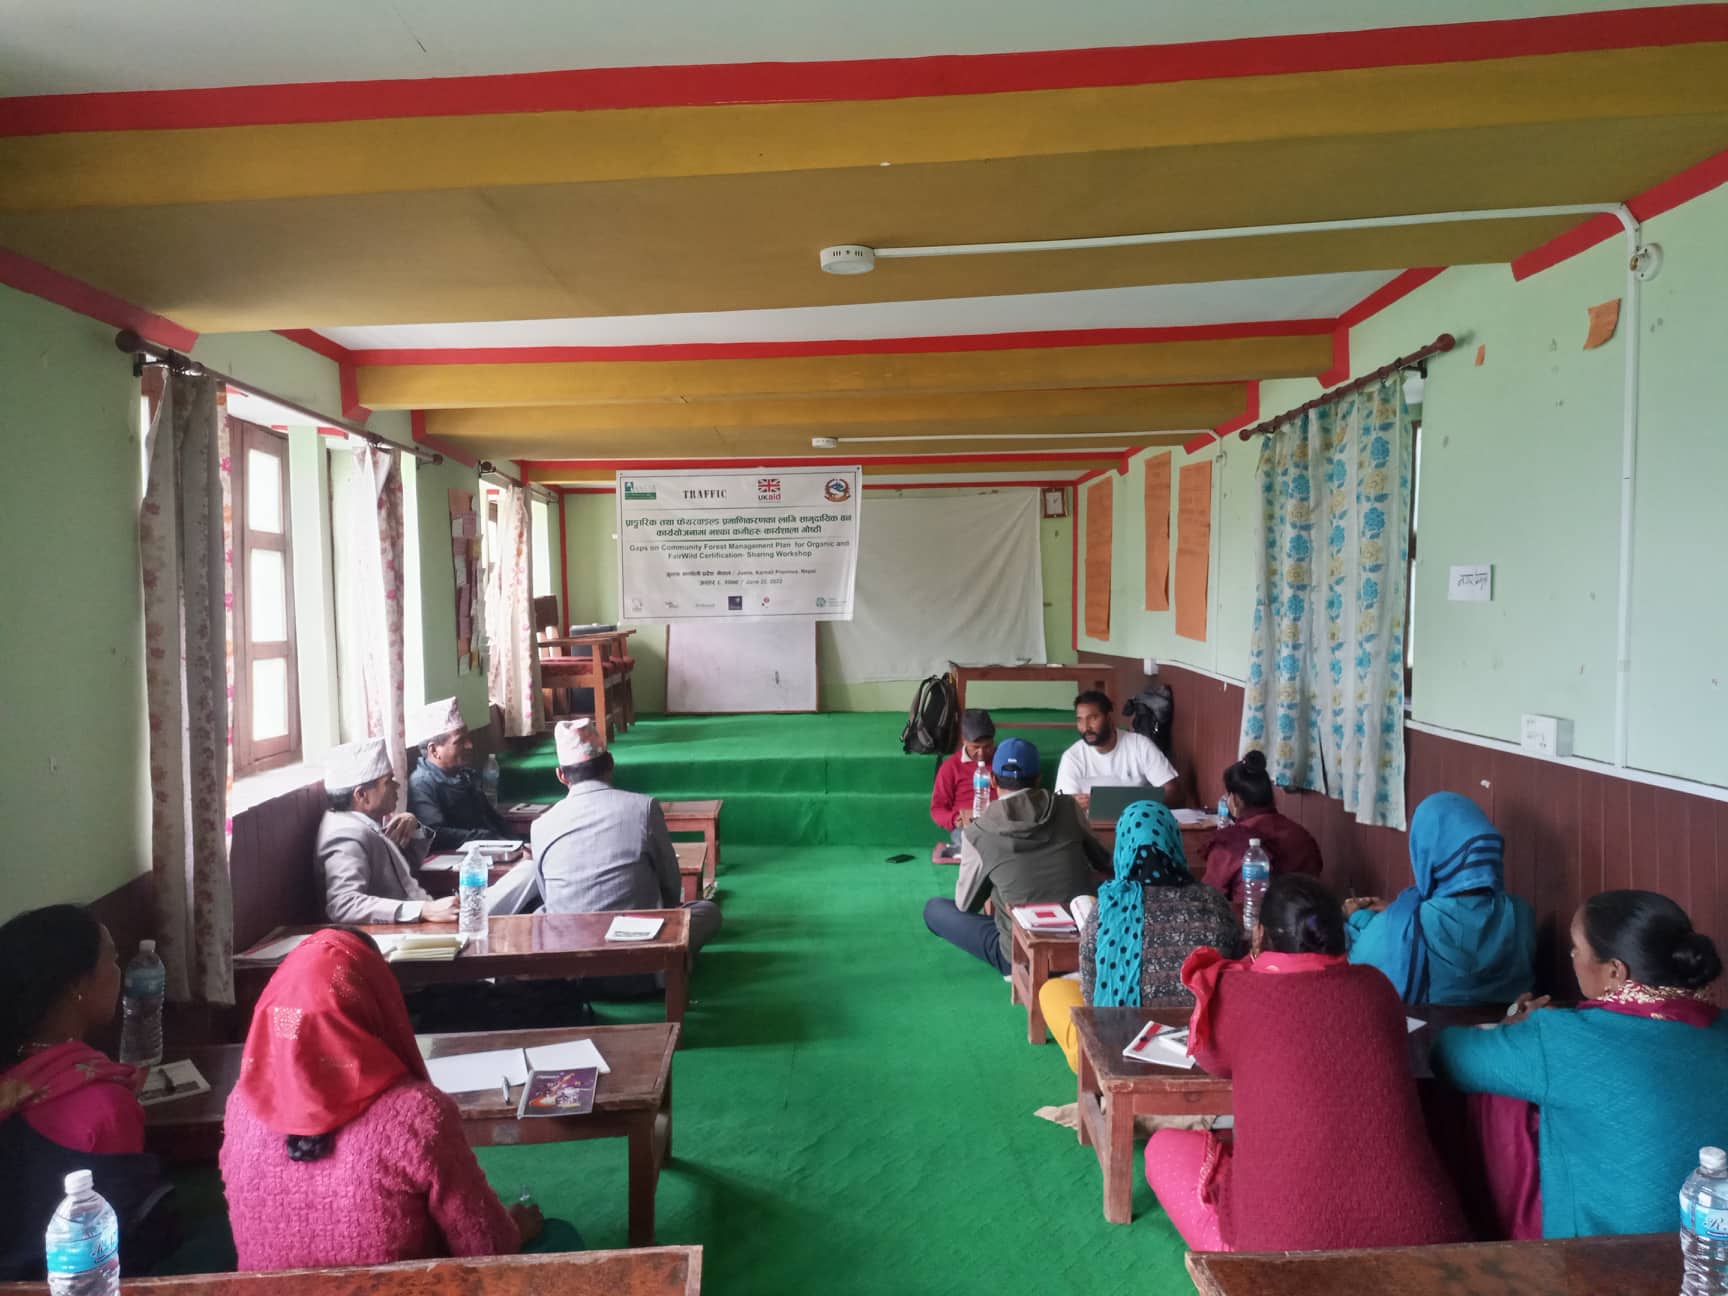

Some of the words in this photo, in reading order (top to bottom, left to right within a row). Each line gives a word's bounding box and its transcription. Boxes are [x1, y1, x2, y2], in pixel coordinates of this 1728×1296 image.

[683, 489, 727, 499] TRAFFIC
[629, 544, 649, 552] Gaps
[661, 543, 702, 552] Community
[728, 542, 774, 550] Management
[806, 541, 835, 549] Organic
[746, 551, 774, 559] Sharing
[775, 550, 812, 558] Workshop
